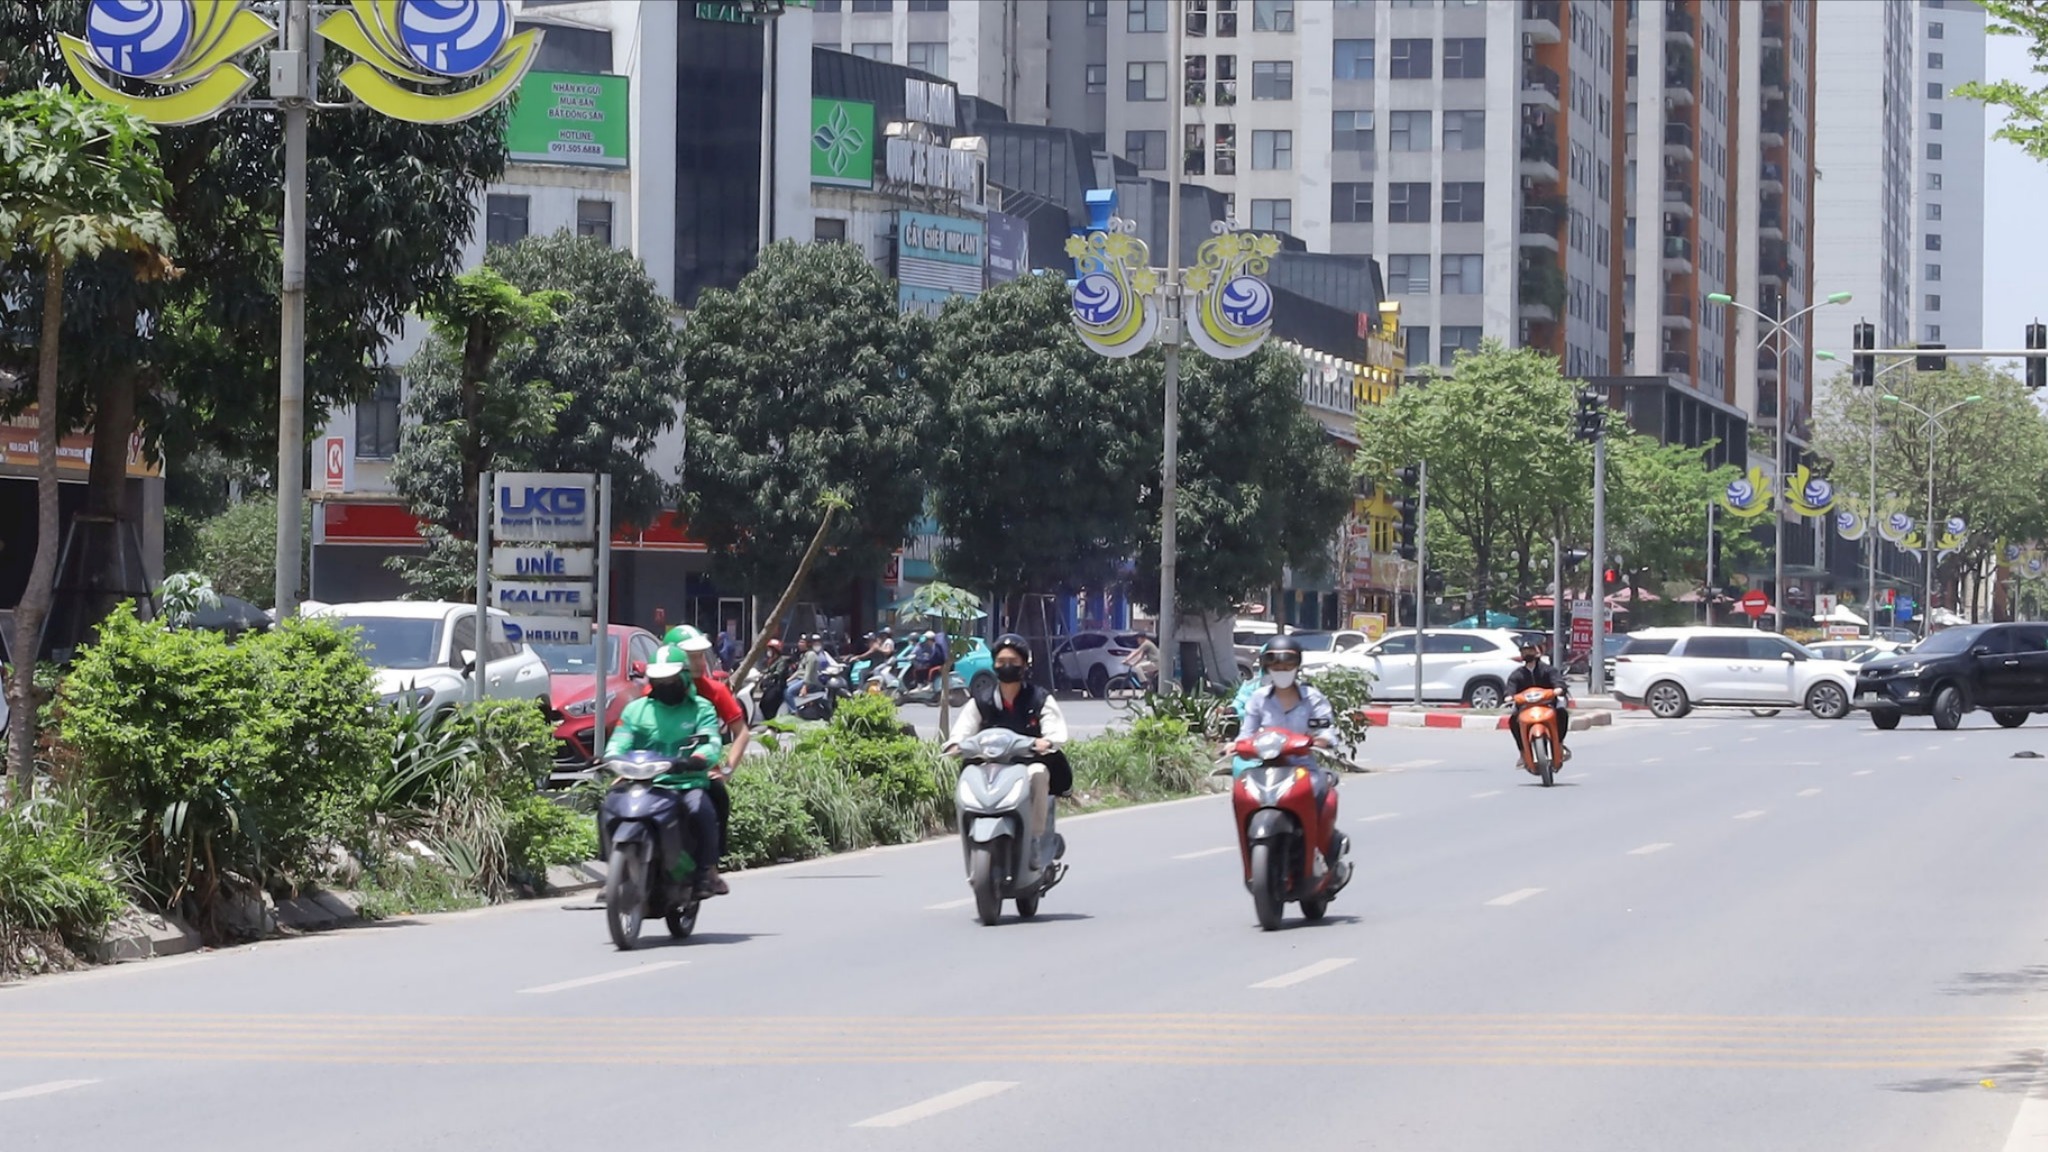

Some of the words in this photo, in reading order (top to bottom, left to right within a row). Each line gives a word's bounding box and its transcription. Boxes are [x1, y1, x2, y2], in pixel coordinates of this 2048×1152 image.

[551, 143, 601, 154] 091.505.6888
[945, 230, 979, 256] IMPLANT
[501, 487, 586, 515] UKG
[515, 550, 566, 574] UNIE
[500, 589, 581, 603] KALITE
